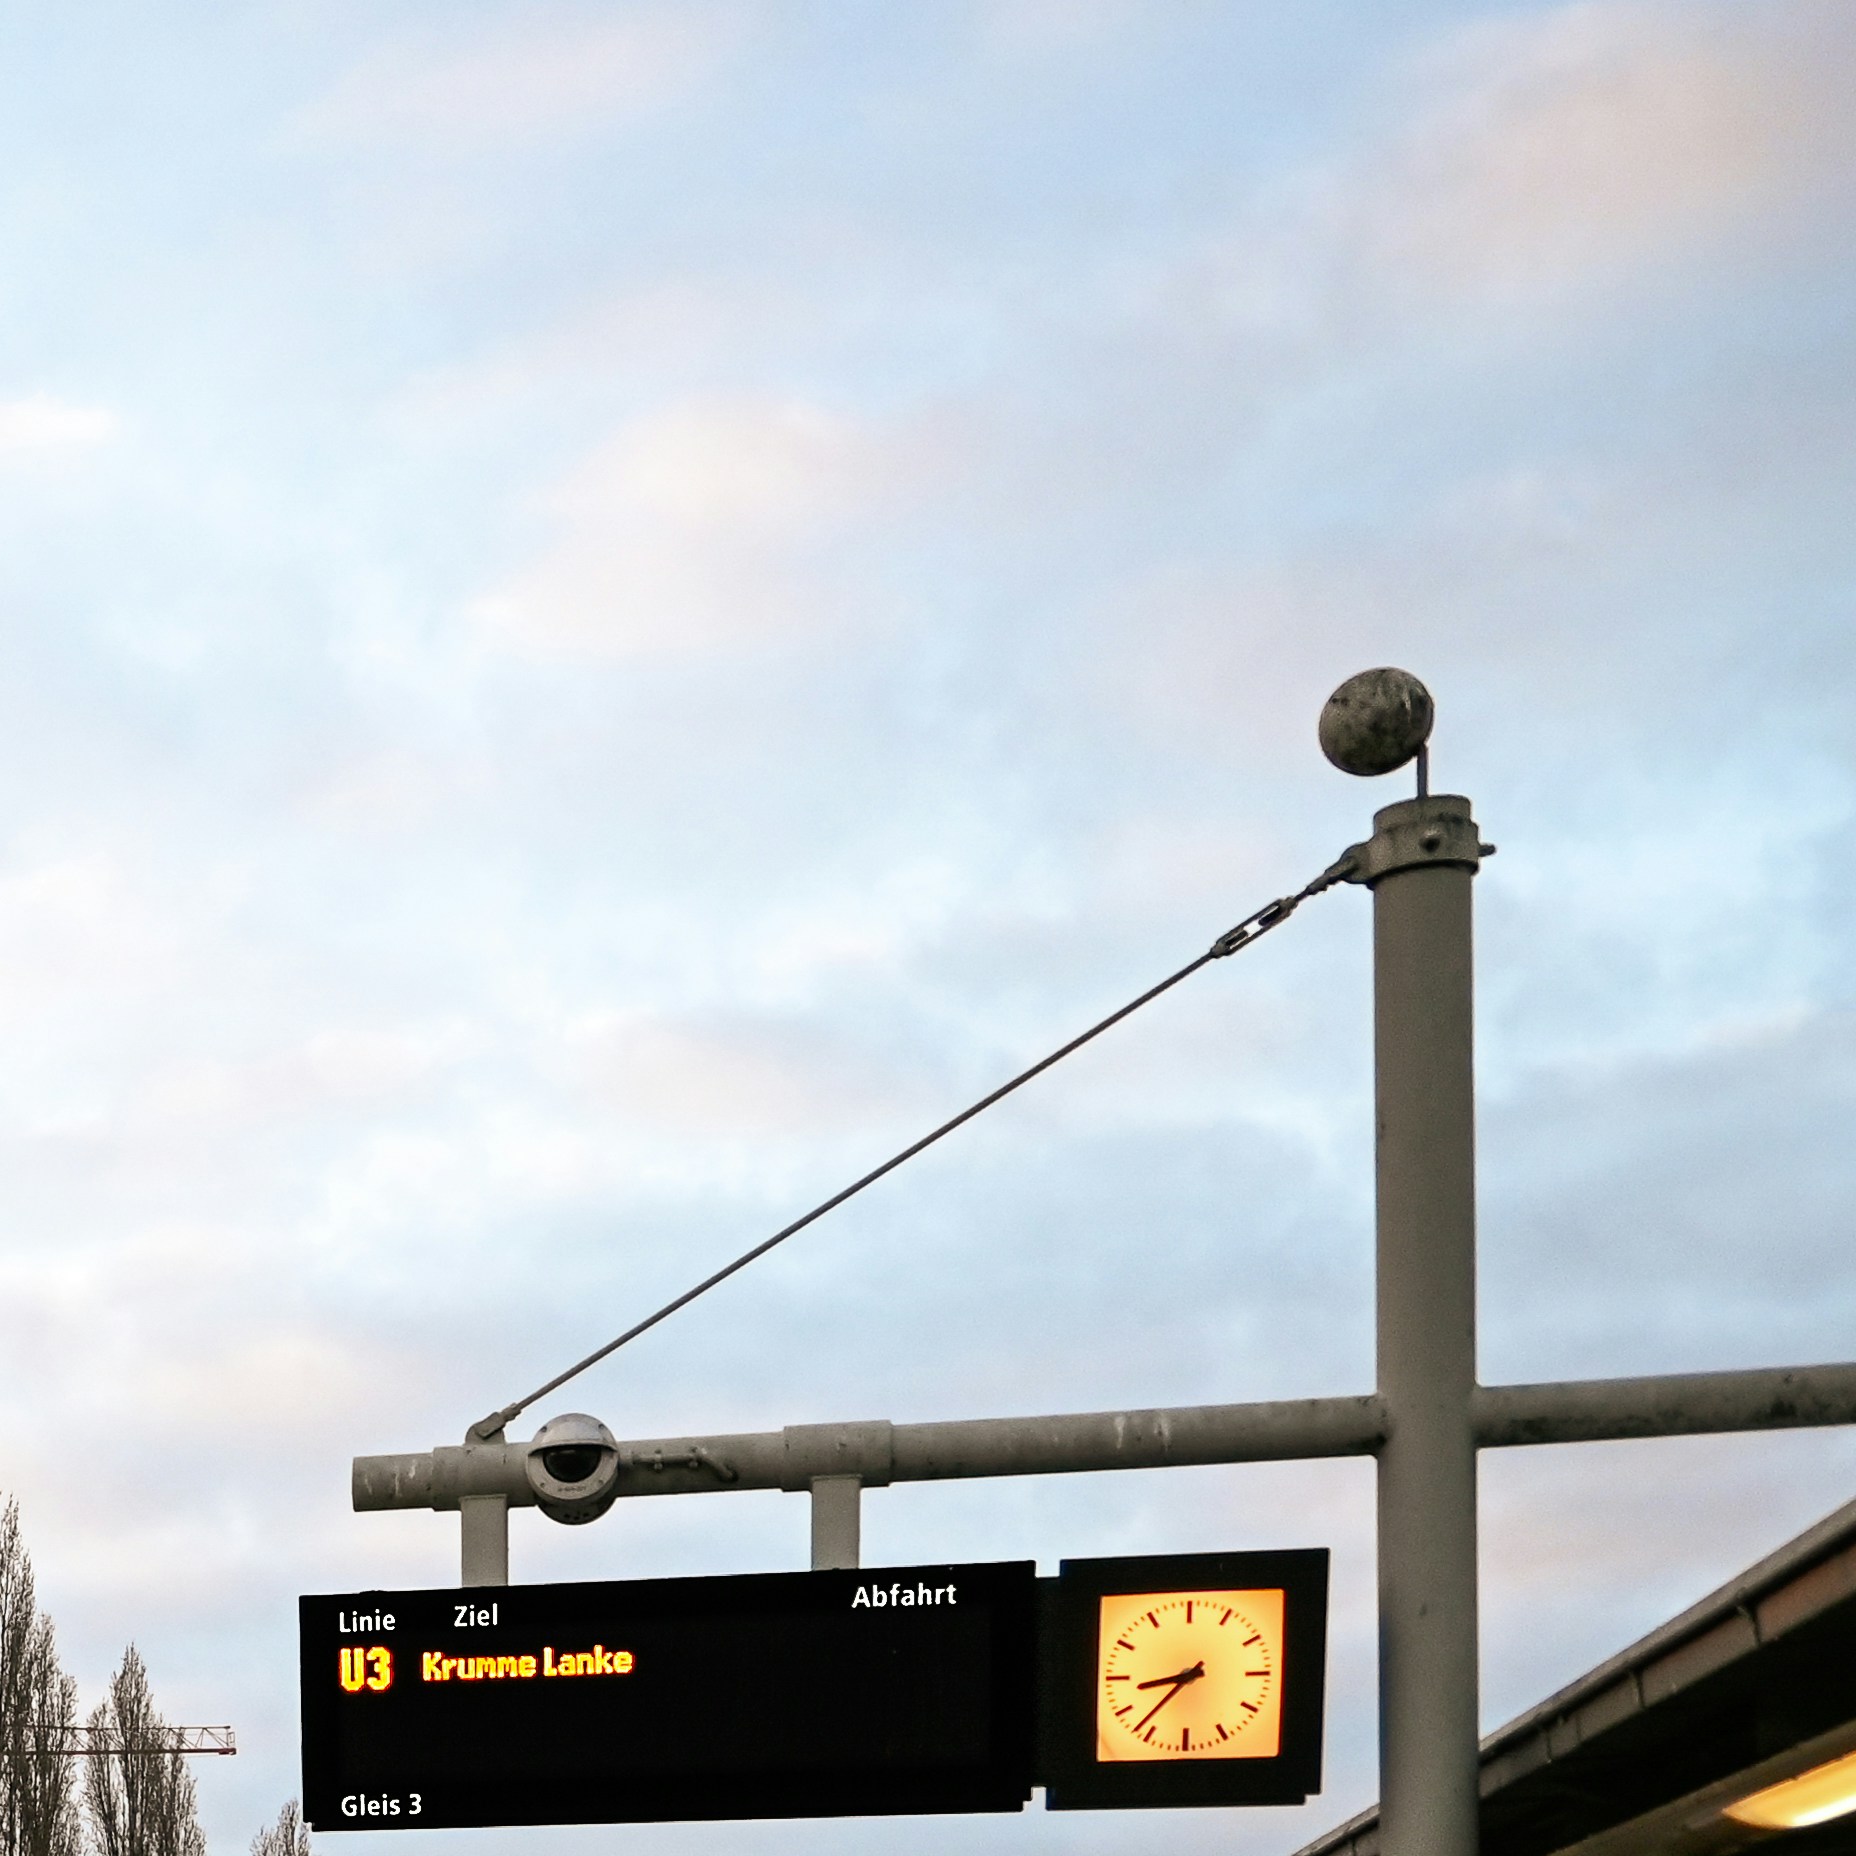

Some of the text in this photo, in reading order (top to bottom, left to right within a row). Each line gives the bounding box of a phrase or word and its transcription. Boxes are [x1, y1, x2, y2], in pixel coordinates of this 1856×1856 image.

[851, 1582, 957, 1609] Abfahrt
[339, 1609, 396, 1633] Linie
[454, 1603, 498, 1627] Ziel
[339, 1645, 634, 1692] U3 Krumme Lanke
[341, 1794, 422, 1817] Gleis 3
